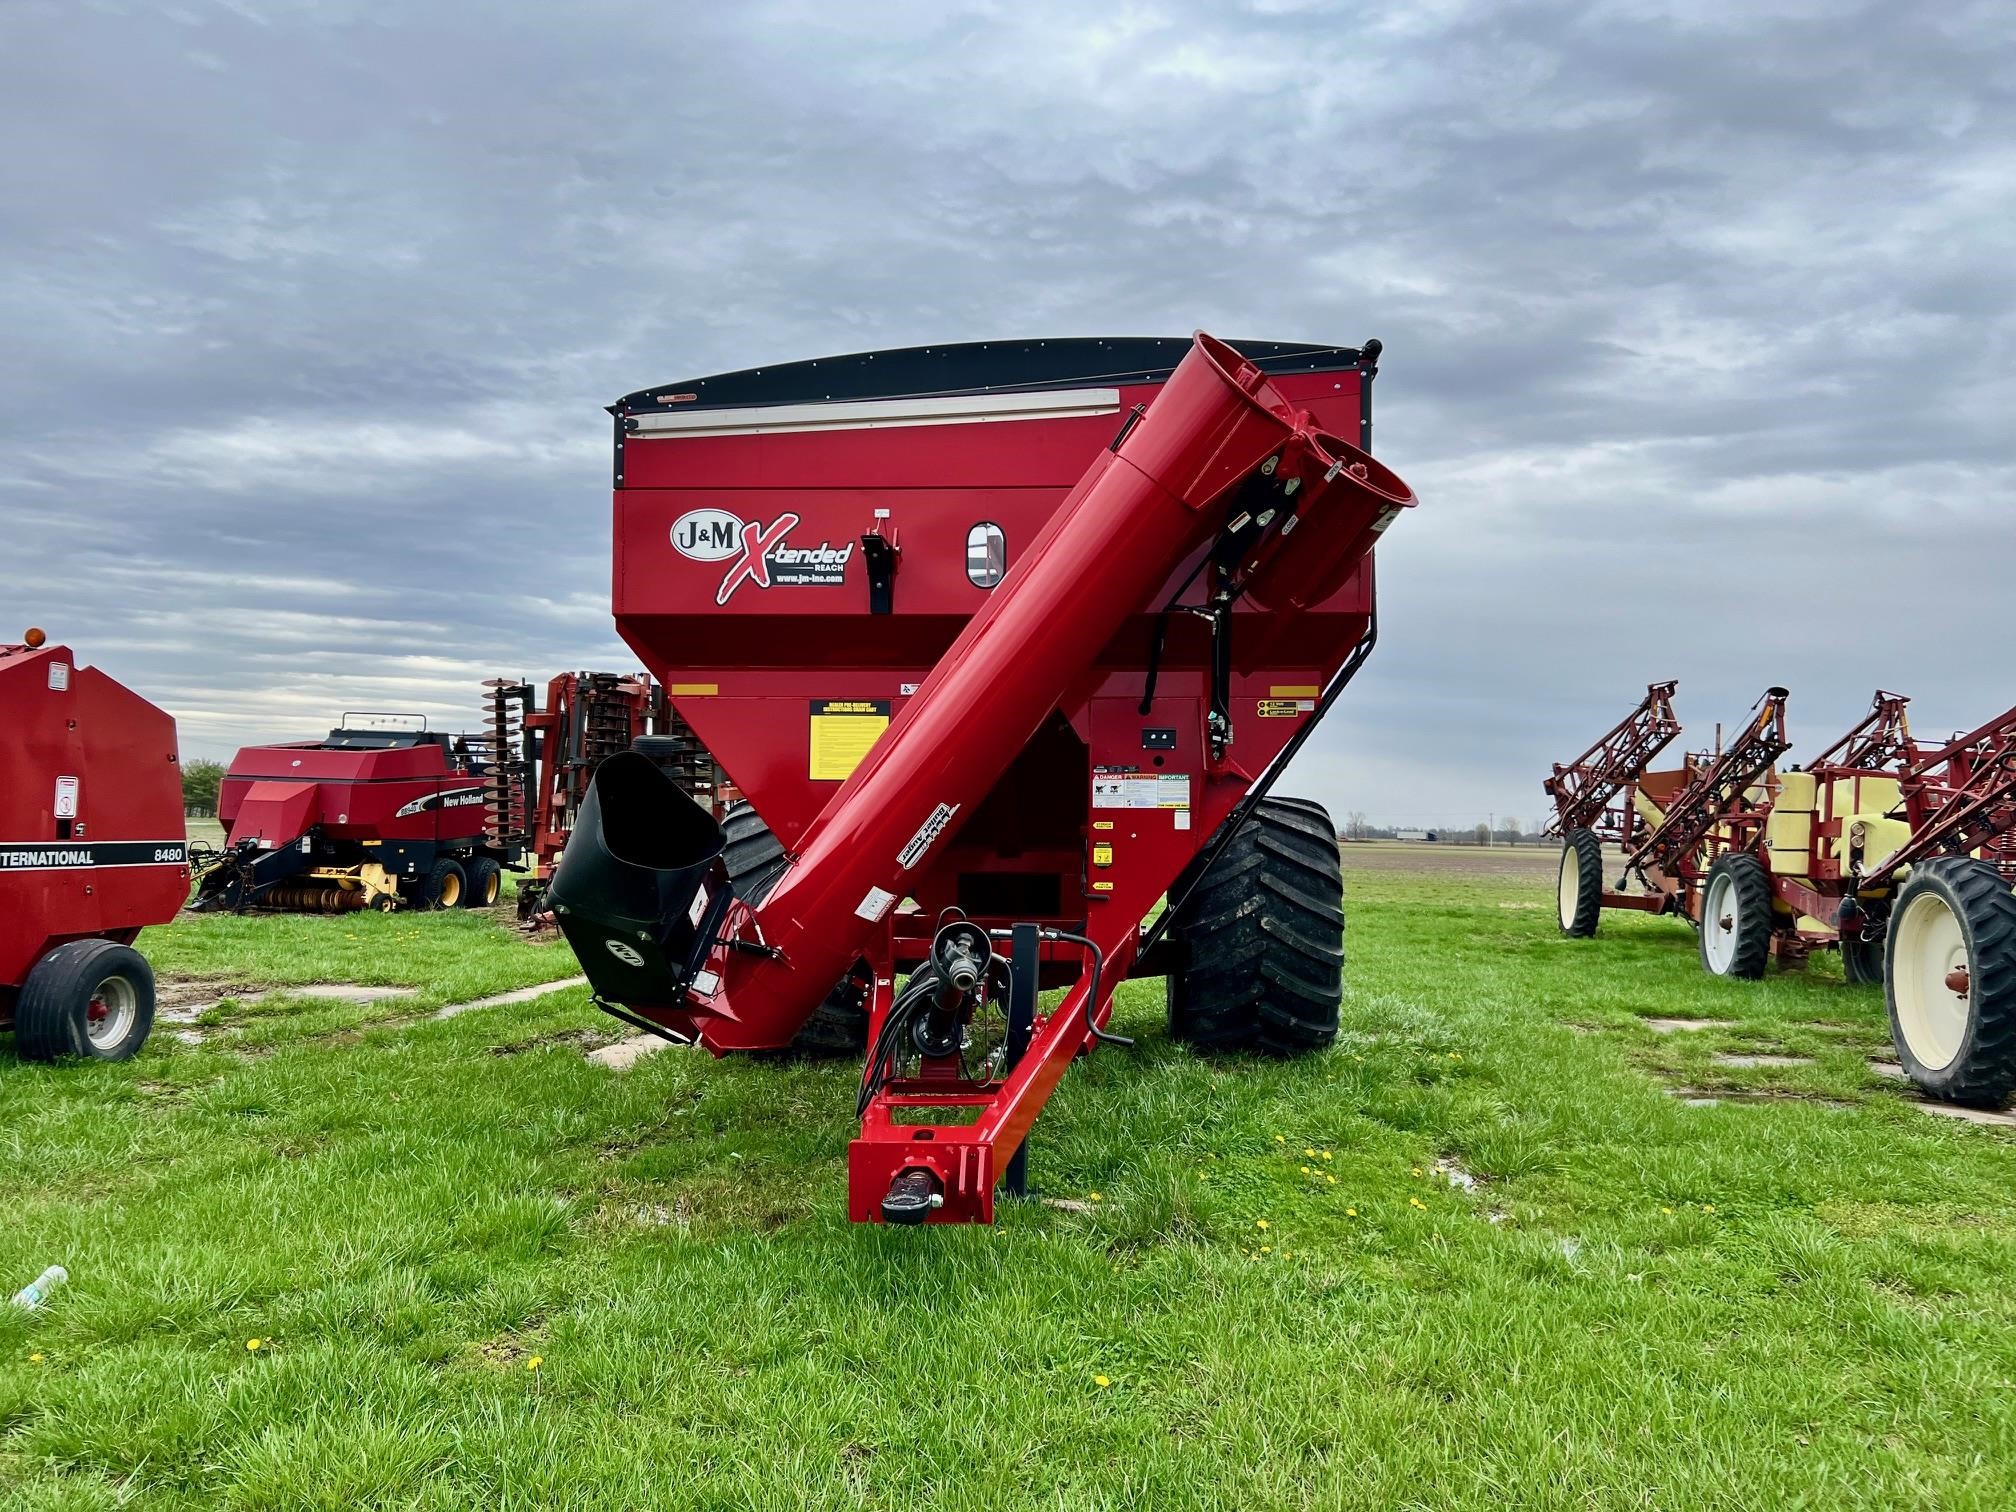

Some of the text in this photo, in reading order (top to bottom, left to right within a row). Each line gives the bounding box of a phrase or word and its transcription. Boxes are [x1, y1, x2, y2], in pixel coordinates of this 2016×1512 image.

[1328, 464, 1340, 478] OPEN
[1283, 515, 1298, 534] CLOSED
[678, 521, 735, 549] J&M
[814, 564, 844, 572] REACH
[776, 574, 843, 584] www.jm-inc.com
[443, 793, 484, 808] New Holland
[902, 806, 946, 861] Bullet Auger
[0, 848, 182, 867] TERNATIONAL 8480
